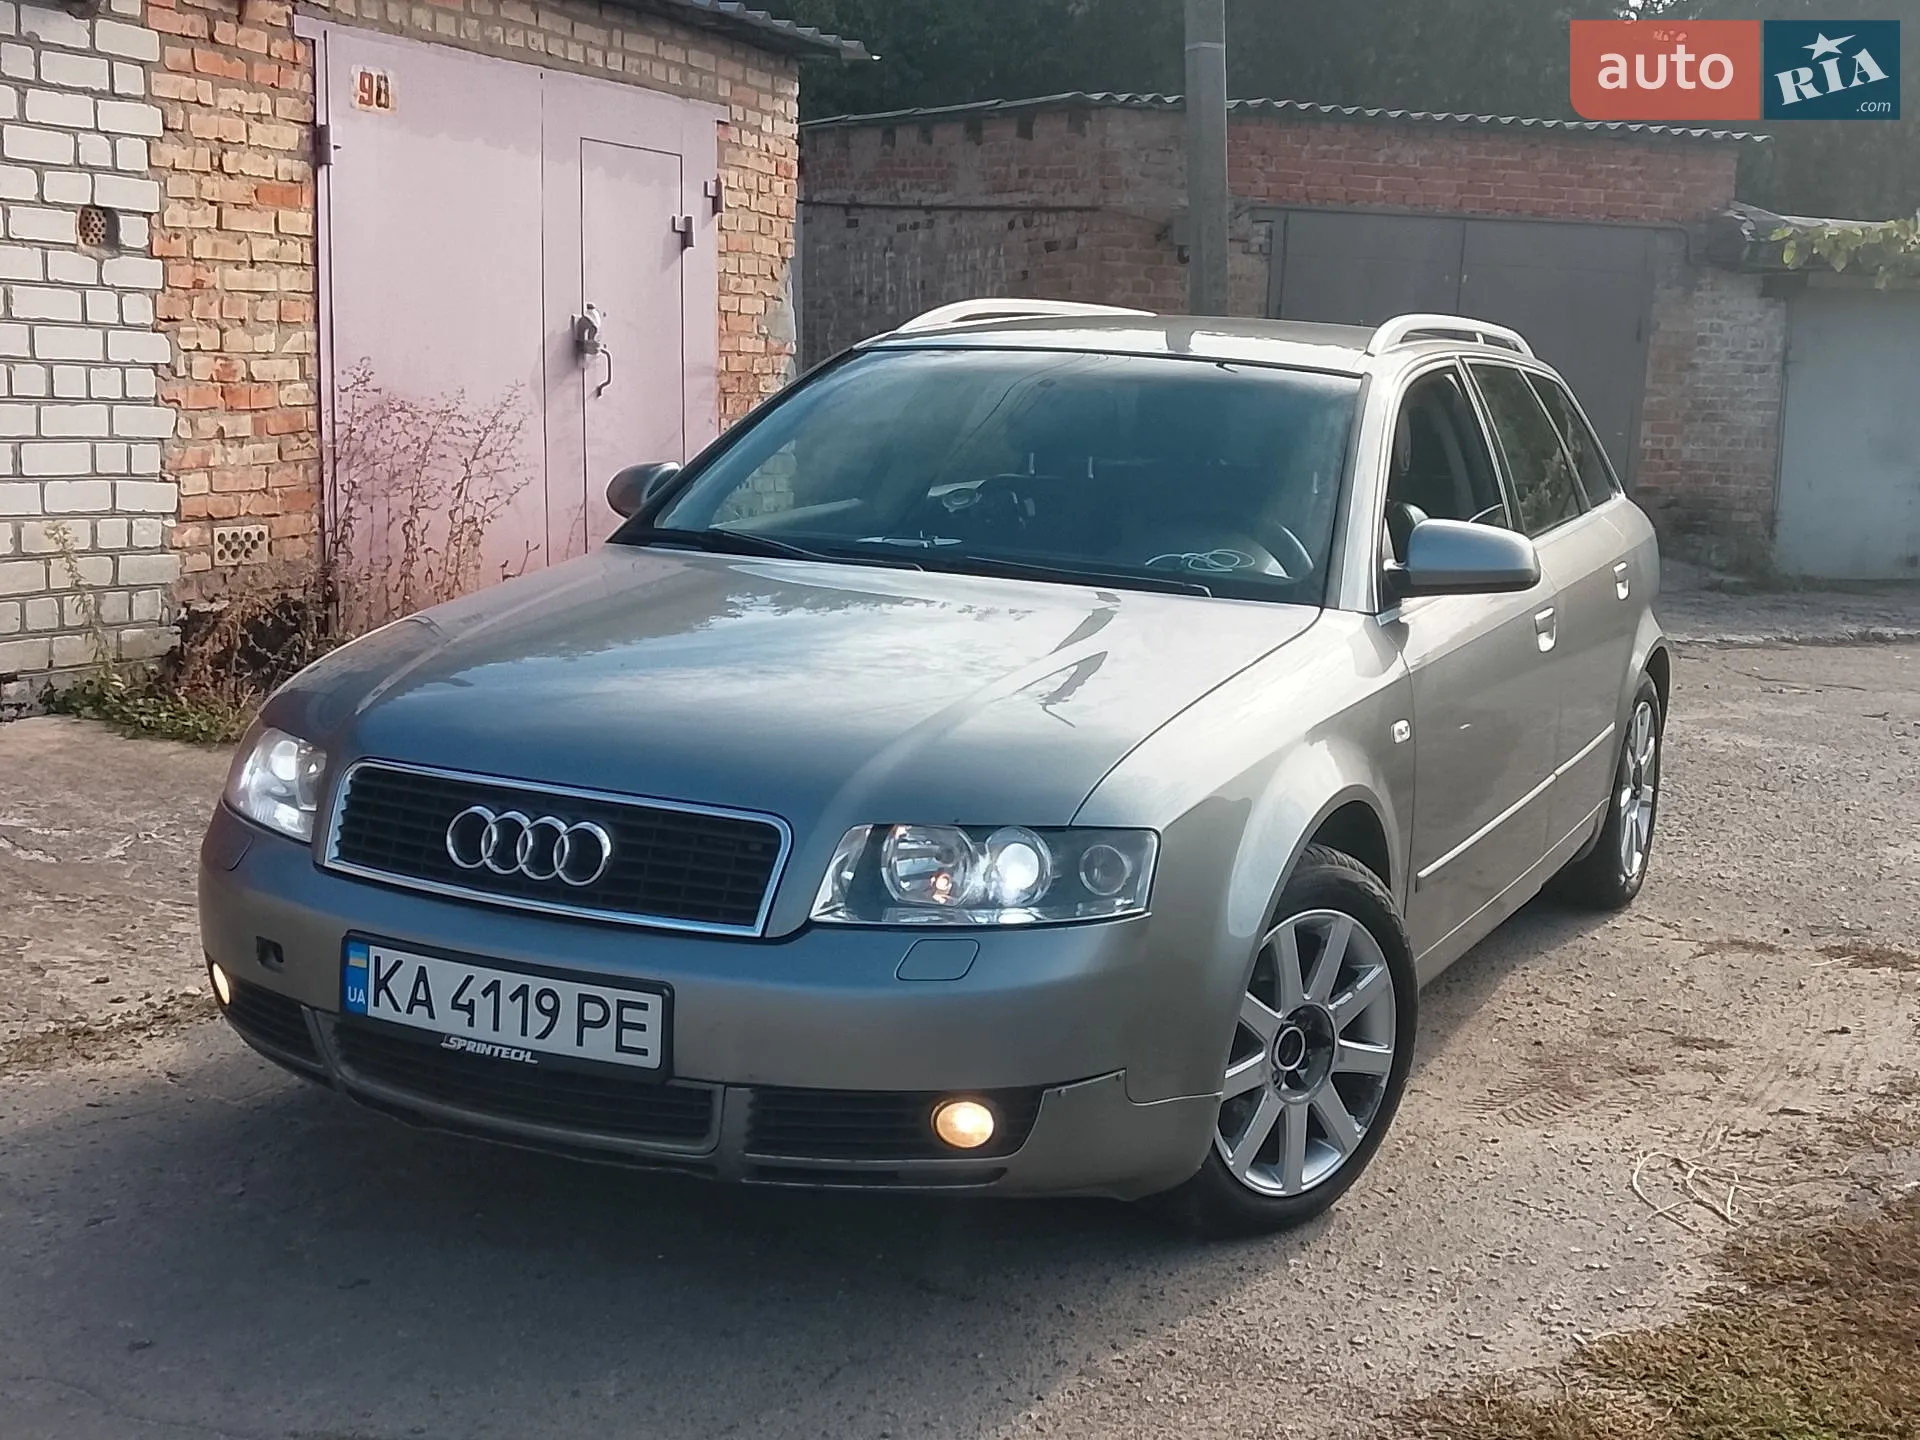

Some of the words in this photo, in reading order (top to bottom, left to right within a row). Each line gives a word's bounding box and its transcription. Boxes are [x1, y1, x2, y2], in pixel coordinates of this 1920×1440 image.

[347, 985, 366, 1006] UA
[373, 955, 436, 1021] KA
[450, 973, 561, 1040] 4119
[575, 992, 650, 1057] PE
